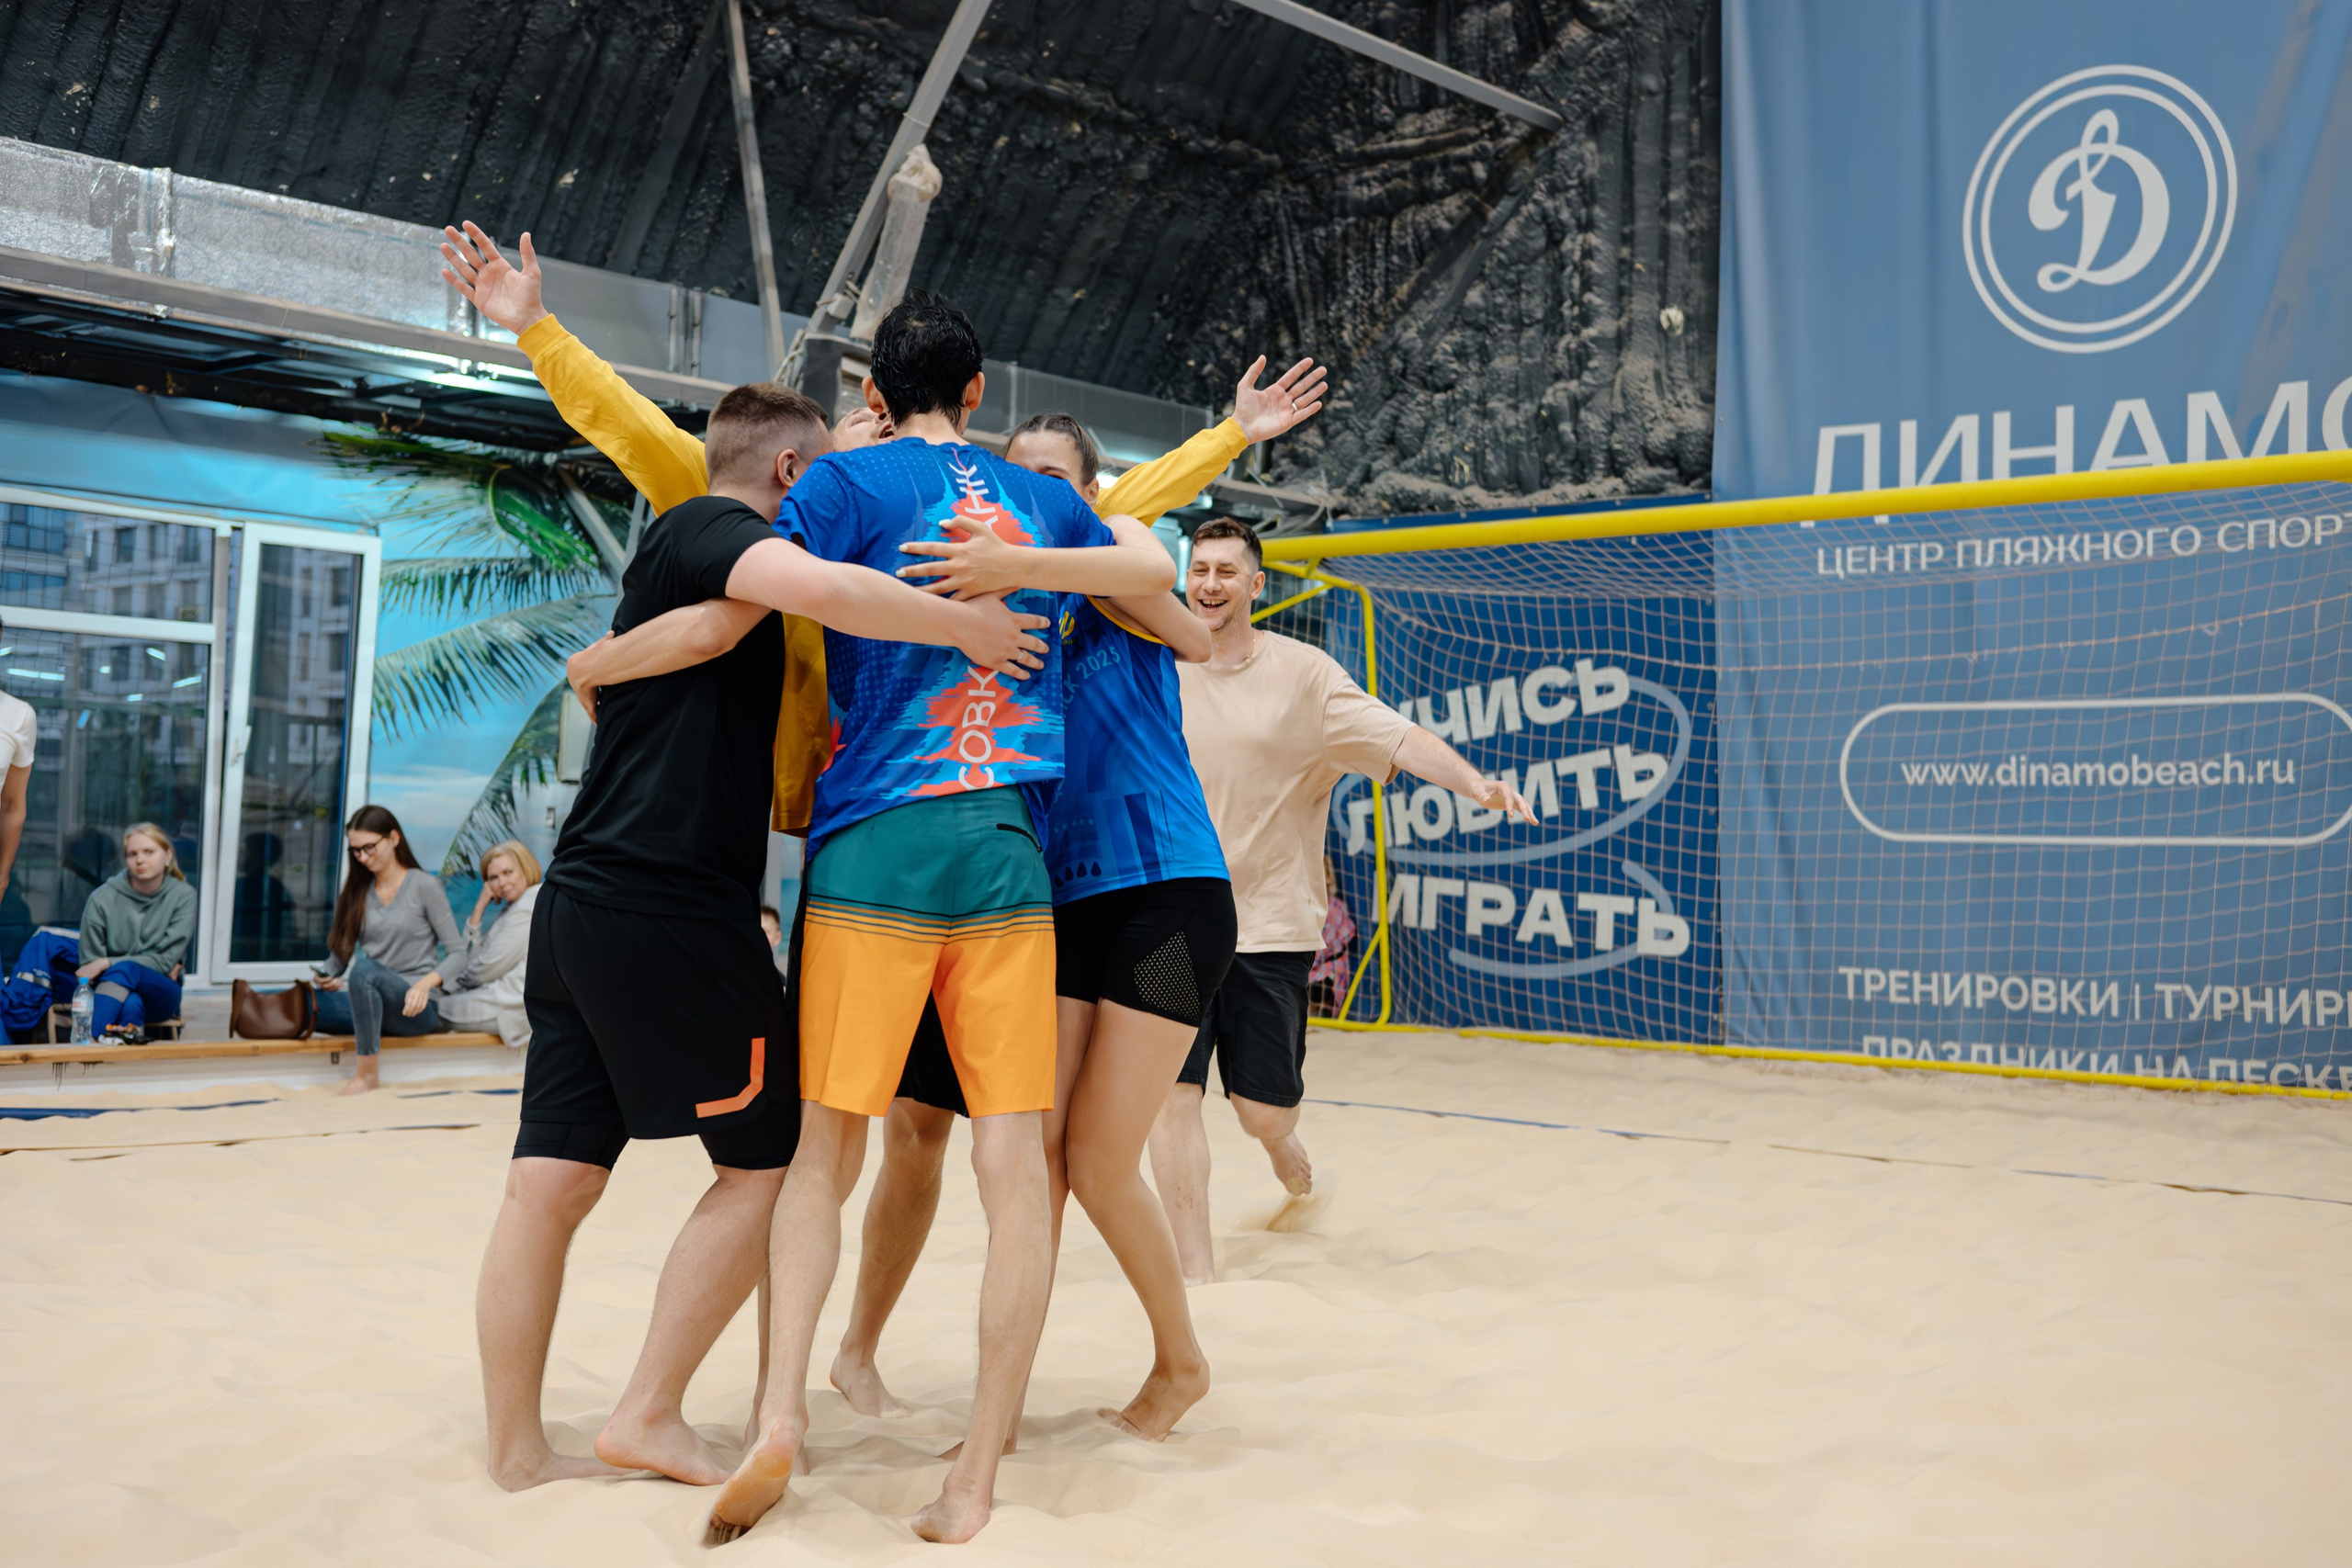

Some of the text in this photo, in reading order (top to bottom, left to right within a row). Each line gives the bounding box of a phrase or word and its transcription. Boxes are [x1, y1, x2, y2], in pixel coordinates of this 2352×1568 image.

[1817, 512, 2352, 579] ЦЕНТР ПЛЯЖНОГО СПОР
[1076, 646, 1121, 680] 2025
[1398, 658, 1630, 745] ЧИСЬ
[1901, 753, 2295, 787] www.dinamobeach.ru
[1371, 869, 1690, 957] ИГРАТЬ
[1838, 966, 2119, 1018] ТРЕНИРОВКИ
[2154, 982, 2352, 1029] ТУРНИР
